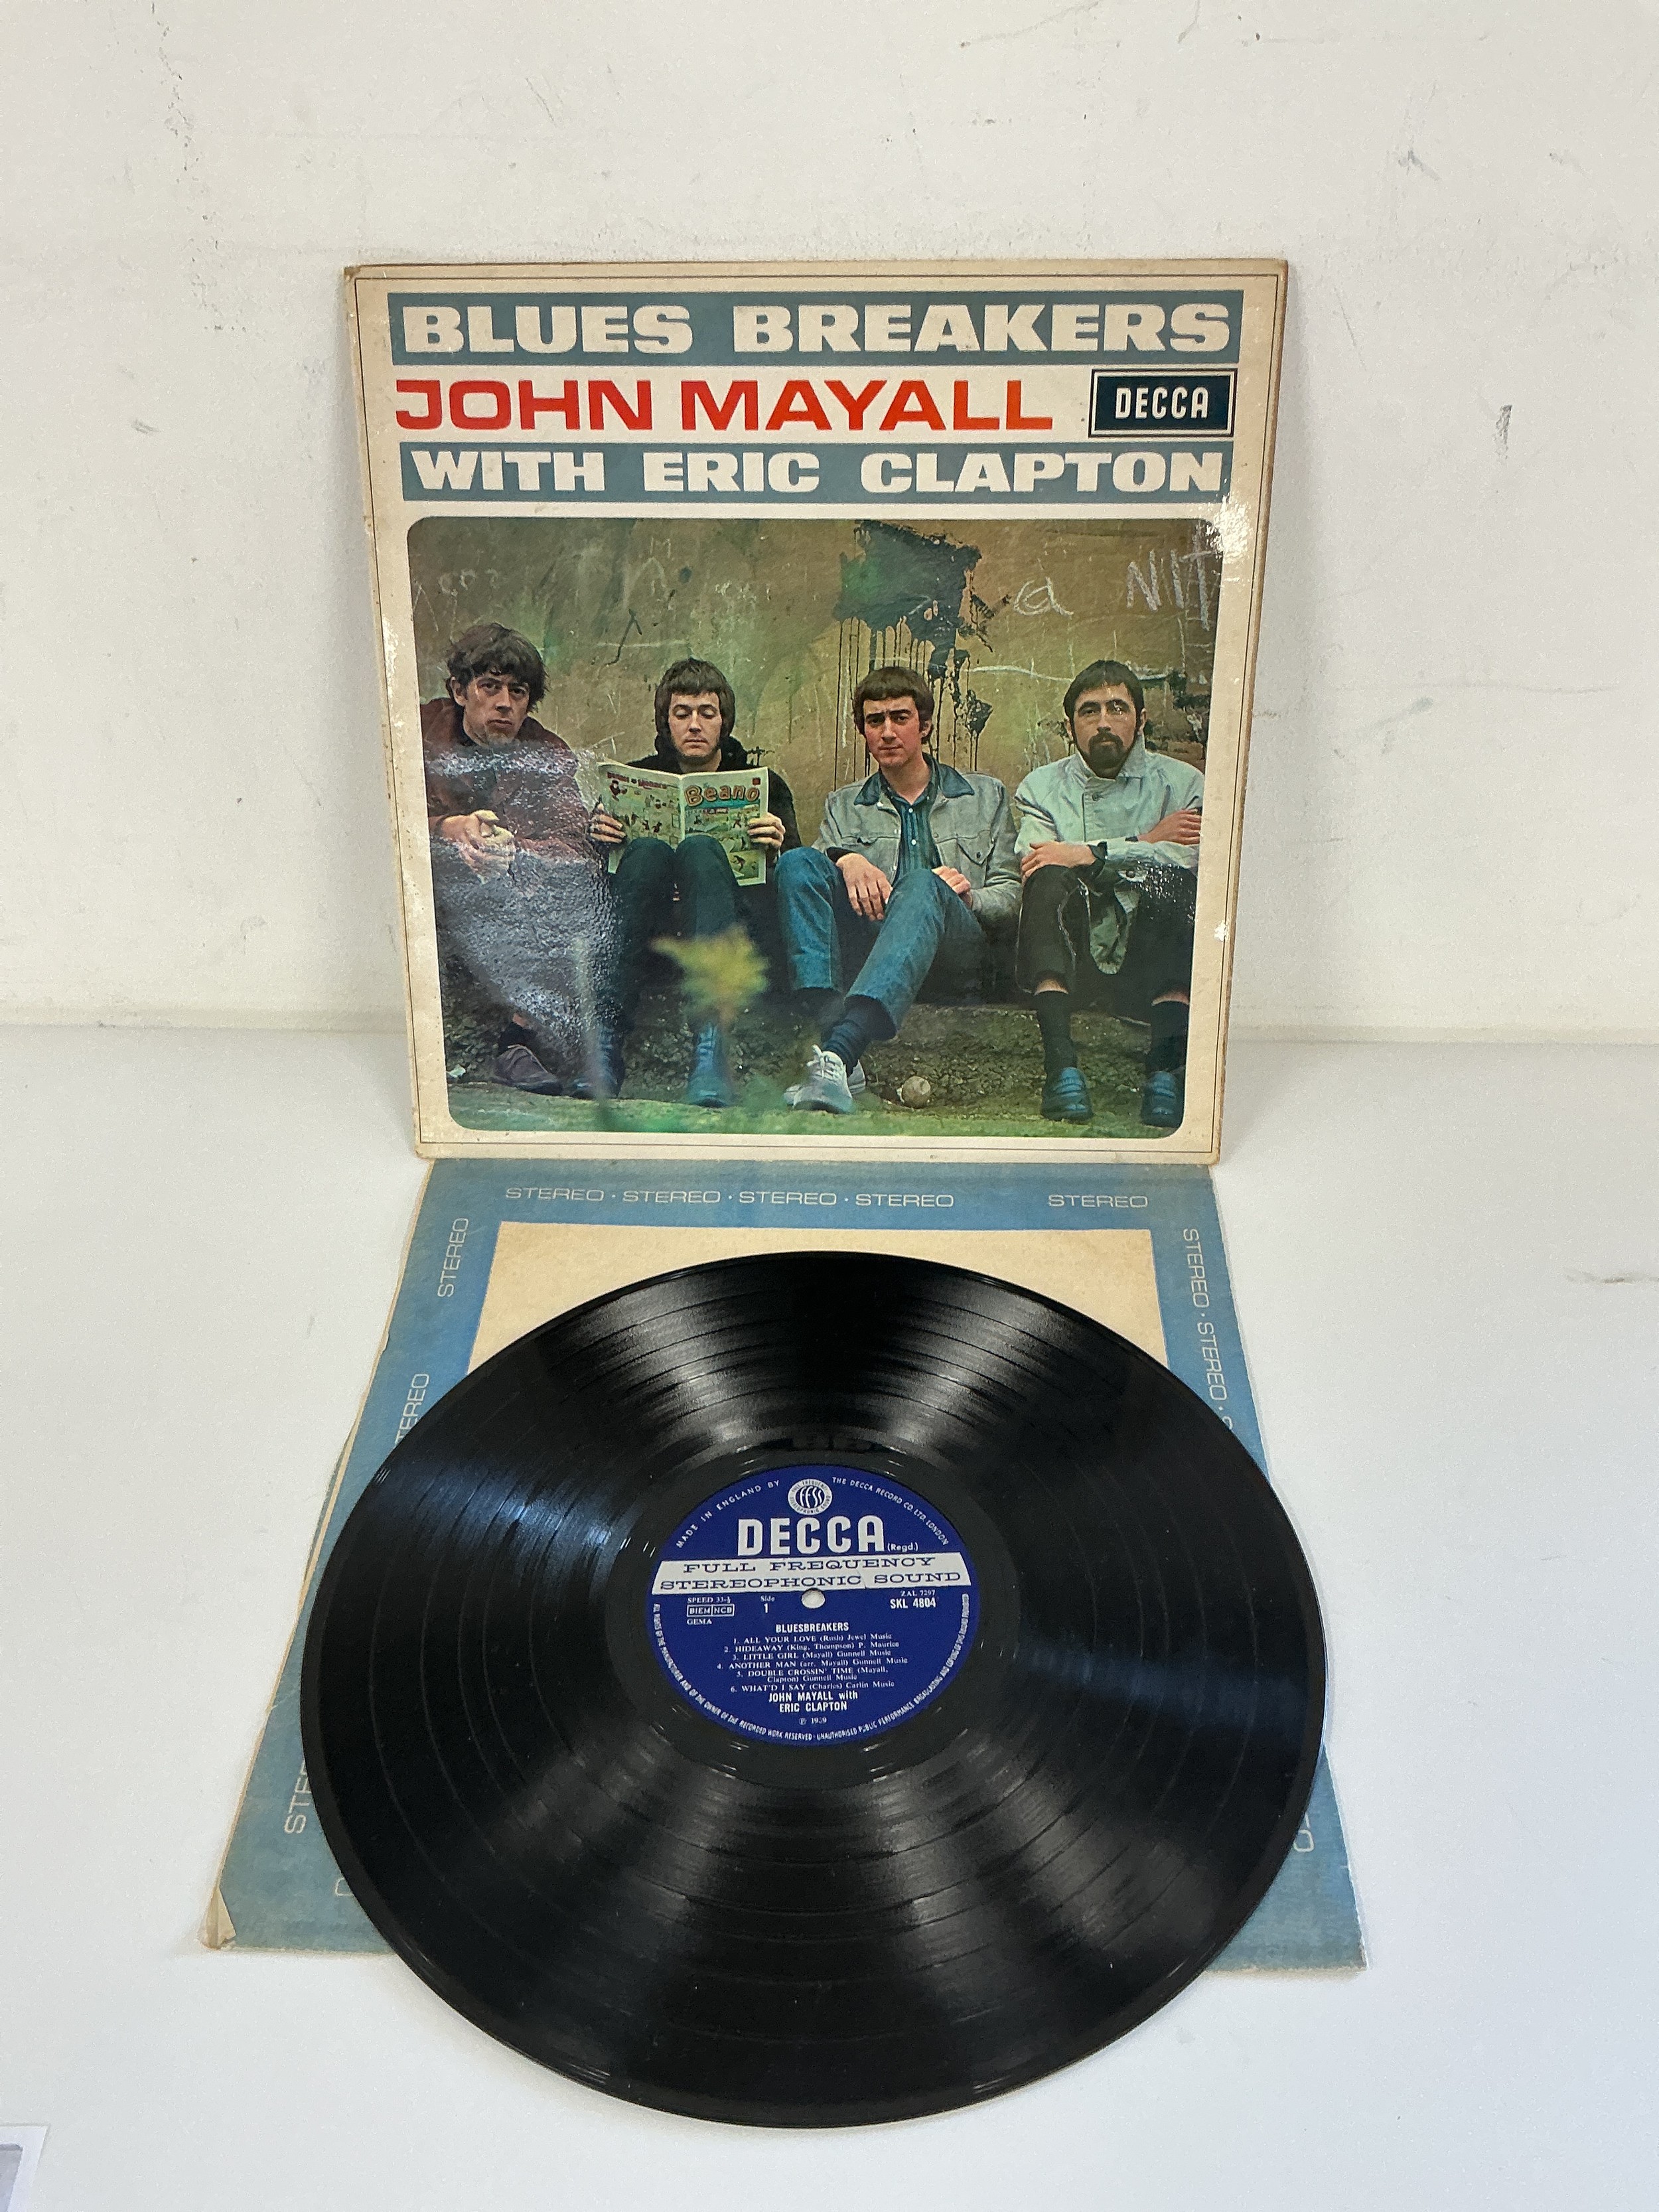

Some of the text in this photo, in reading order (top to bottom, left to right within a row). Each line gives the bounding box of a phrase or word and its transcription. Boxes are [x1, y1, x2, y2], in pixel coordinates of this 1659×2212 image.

[402, 303, 1230, 354] BLUES BREAKERS
[396, 380, 1054, 431] JOHN MAYALL
[1115, 386, 1209, 419] DECCA
[411, 450, 1224, 493] WITH ERIC CLAPTON
[684, 784, 760, 806] Beano
[505, 1187, 954, 1208] STEREO STEREO STEREO STEREO
[1048, 1194, 1149, 1209] STEREO
[437, 1217, 470, 1298] STEREO
[1183, 1228, 1210, 1308] STEREO
[1197, 1321, 1228, 1402] STEREO
[394, 1373, 430, 1445] TEREO
[676, 1479, 780, 1549] MADE IN ENGLAND BY
[831, 1477, 847, 1486] THE
[850, 1479, 874, 1492] DECCA
[875, 1487, 903, 1505] RECORD
[926, 1519, 950, 1546] LONDON
[737, 1514, 885, 1557] DECCA
[660, 1572, 961, 1590] STEREOPHONIC SOUND
[683, 1557, 935, 1573] FULL FREQUENCY
[763, 1603, 769, 1613] 1
[890, 1597, 936, 1609] SKL 4804
[775, 1622, 849, 1633] BLUESBREAKERS
[768, 1690, 859, 1703] JOHN MAYALL with
[779, 1701, 847, 1713] ERIC CLAPTON
[784, 1732, 812, 1741] RESERVED
[877, 1701, 915, 1726] PERFORMANCE
